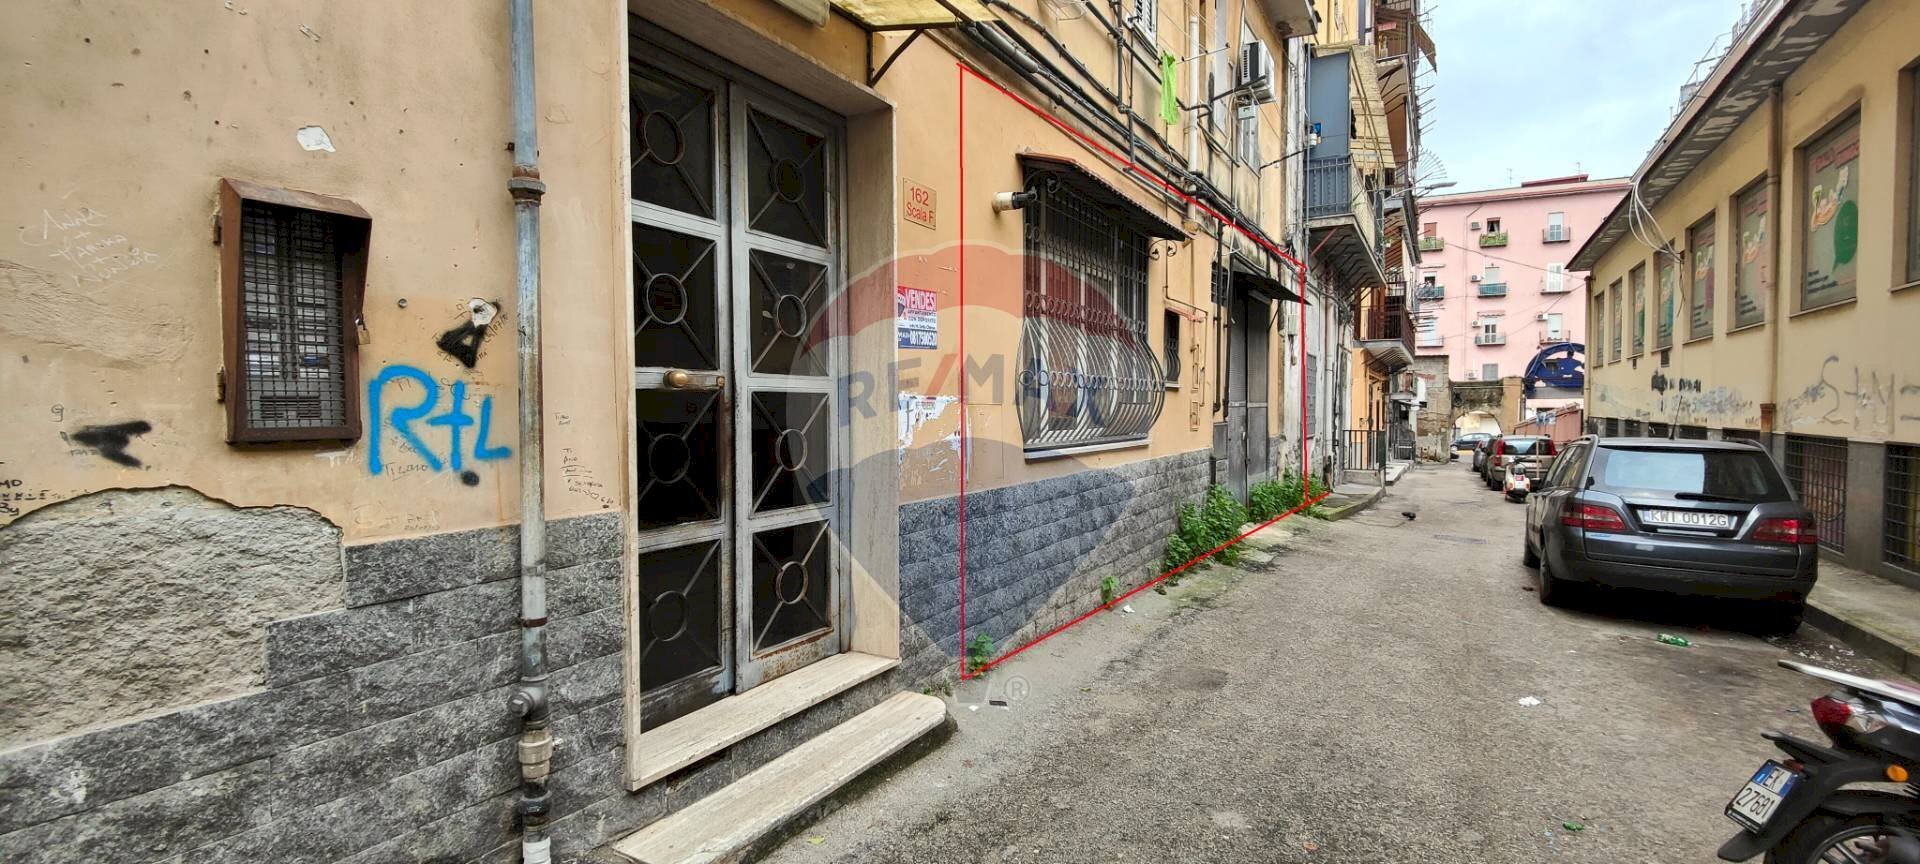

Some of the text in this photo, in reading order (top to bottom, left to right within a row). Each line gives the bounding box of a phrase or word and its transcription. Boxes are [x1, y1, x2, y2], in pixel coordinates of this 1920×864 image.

[910, 186, 929, 207] 162
[906, 201, 935, 224] Scala F
[1735, 787, 1776, 819] 27681
